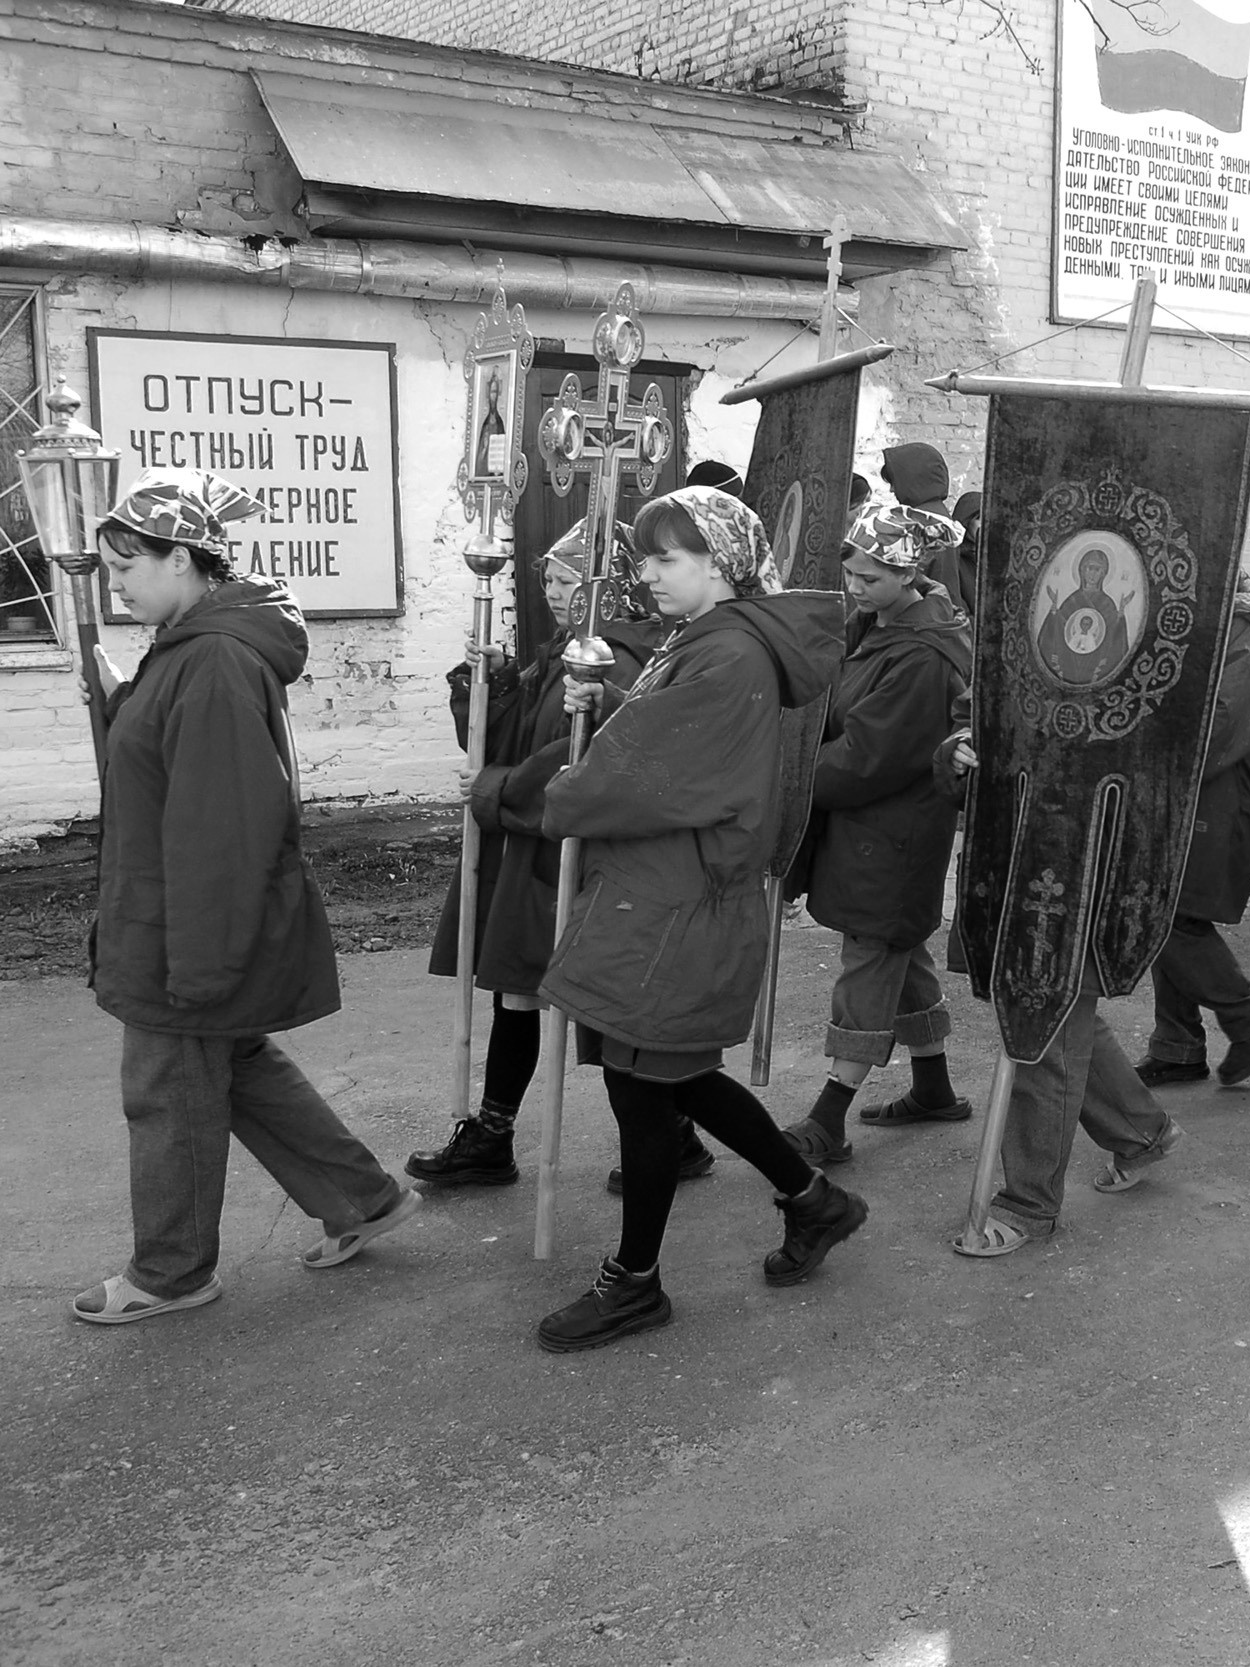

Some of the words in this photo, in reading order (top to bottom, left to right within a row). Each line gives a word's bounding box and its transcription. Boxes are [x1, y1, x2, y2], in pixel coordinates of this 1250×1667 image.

[1186, 131, 1202, 146] УИК
[1206, 135, 1219, 148] РФ
[1065, 149, 1140, 176] ДАТЕЛЬСТВО
[1148, 160, 1212, 188] РОССИЙСКОЙ
[1065, 170, 1088, 190] ЦИИ
[1093, 174, 1133, 196] ИМЕЕТ
[1137, 181, 1180, 203] СВОИМИ
[1185, 188, 1229, 211] ЦЕЛЯМИ
[1064, 191, 1147, 219] ИСПРАВЛЕНИЕ
[1154, 204, 1228, 231] ОСУЖДЕННЫХ
[1231, 216, 1239, 233] И
[1063, 234, 1103, 256] НОВЫХ
[1110, 240, 1195, 267] ПРЕСТУПЛЕНИЙ
[1200, 252, 1220, 270] КАК
[1064, 212, 1169, 243] ПРЕДУПРЕЖДЕНИЕ
[1176, 228, 1246, 254] СОВЕРШЕНИЯ
[1129, 263, 1152, 281] ТА
[1159, 267, 1168, 285] И
[1173, 269, 1216, 290] ИНЫМИ
[129, 428, 275, 471] ЧЕСТНЫЙ
[295, 434, 369, 472] ТРУД
[228, 540, 340, 577] ЕДЕНИЕ
